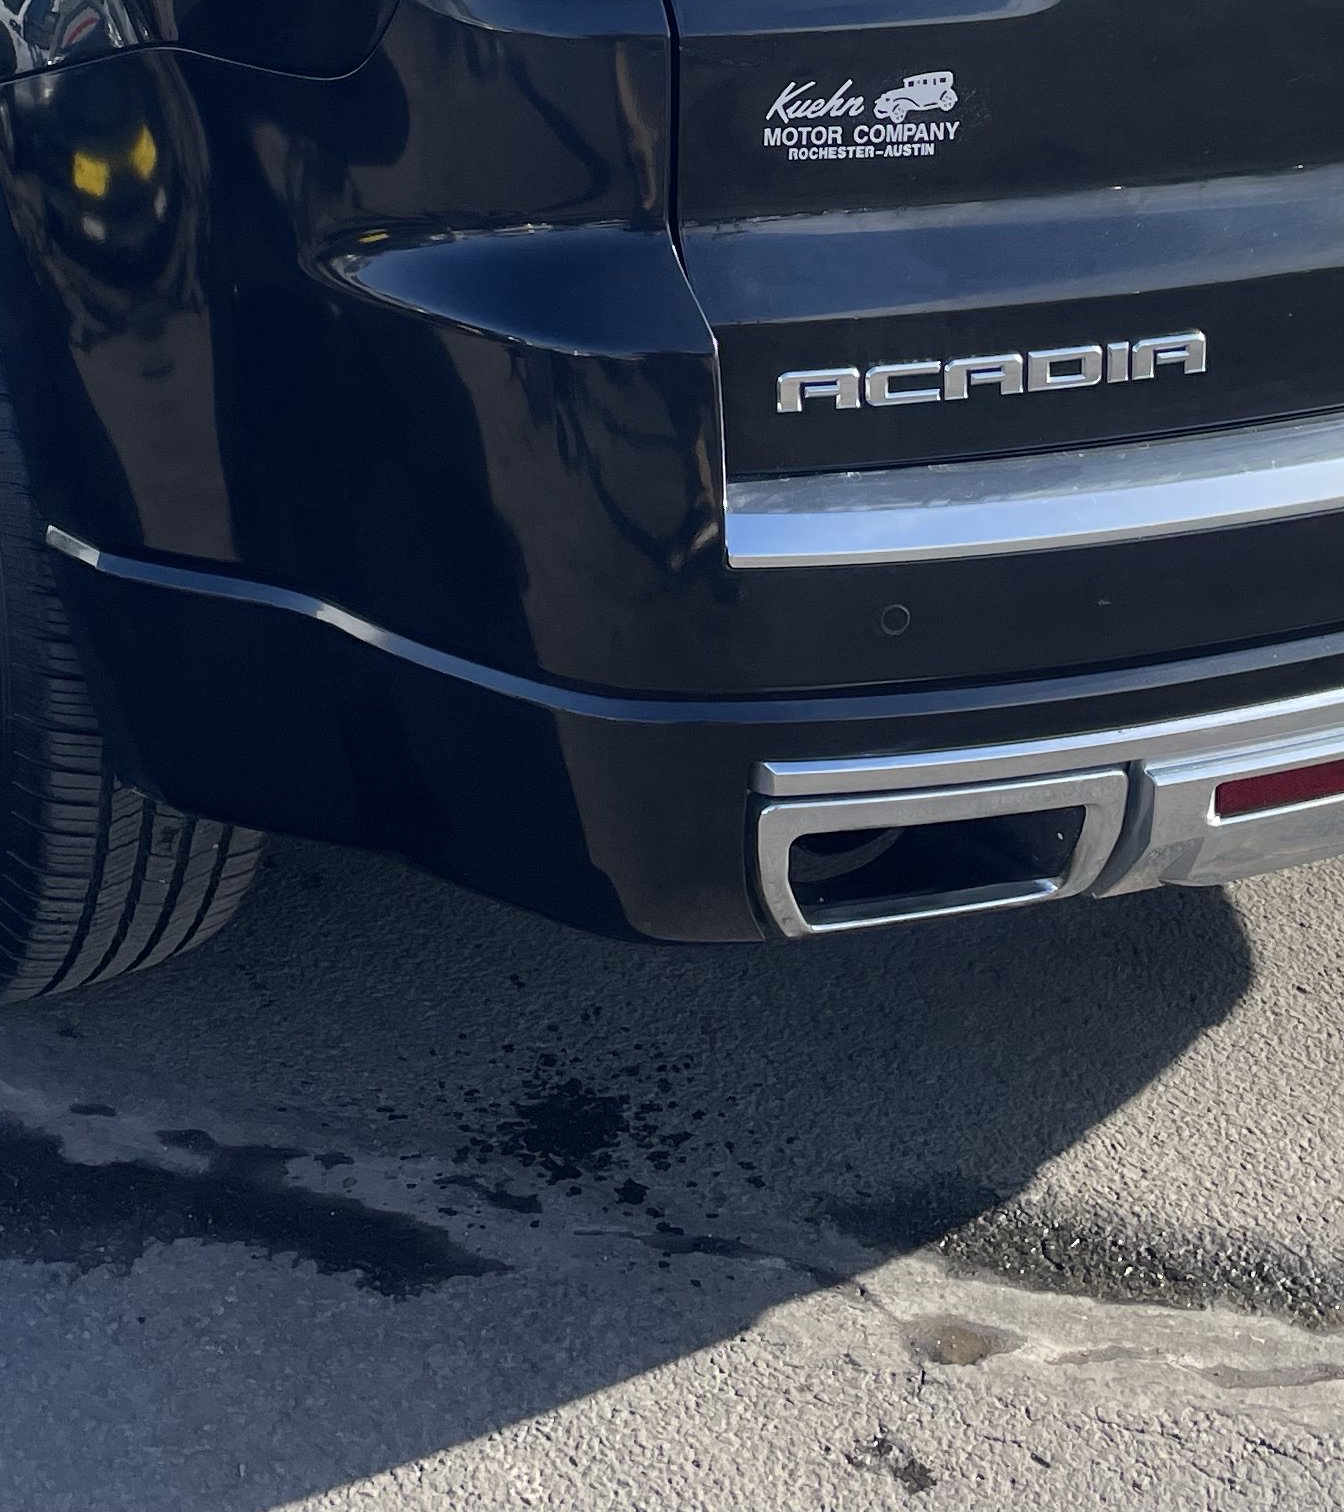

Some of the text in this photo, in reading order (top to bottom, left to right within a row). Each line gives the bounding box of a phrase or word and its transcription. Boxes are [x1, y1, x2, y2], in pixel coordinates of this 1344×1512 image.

[765, 79, 865, 124] Kuehn
[763, 121, 960, 146] MOTOR COMPANY
[776, 330, 1208, 414] ACADIA
